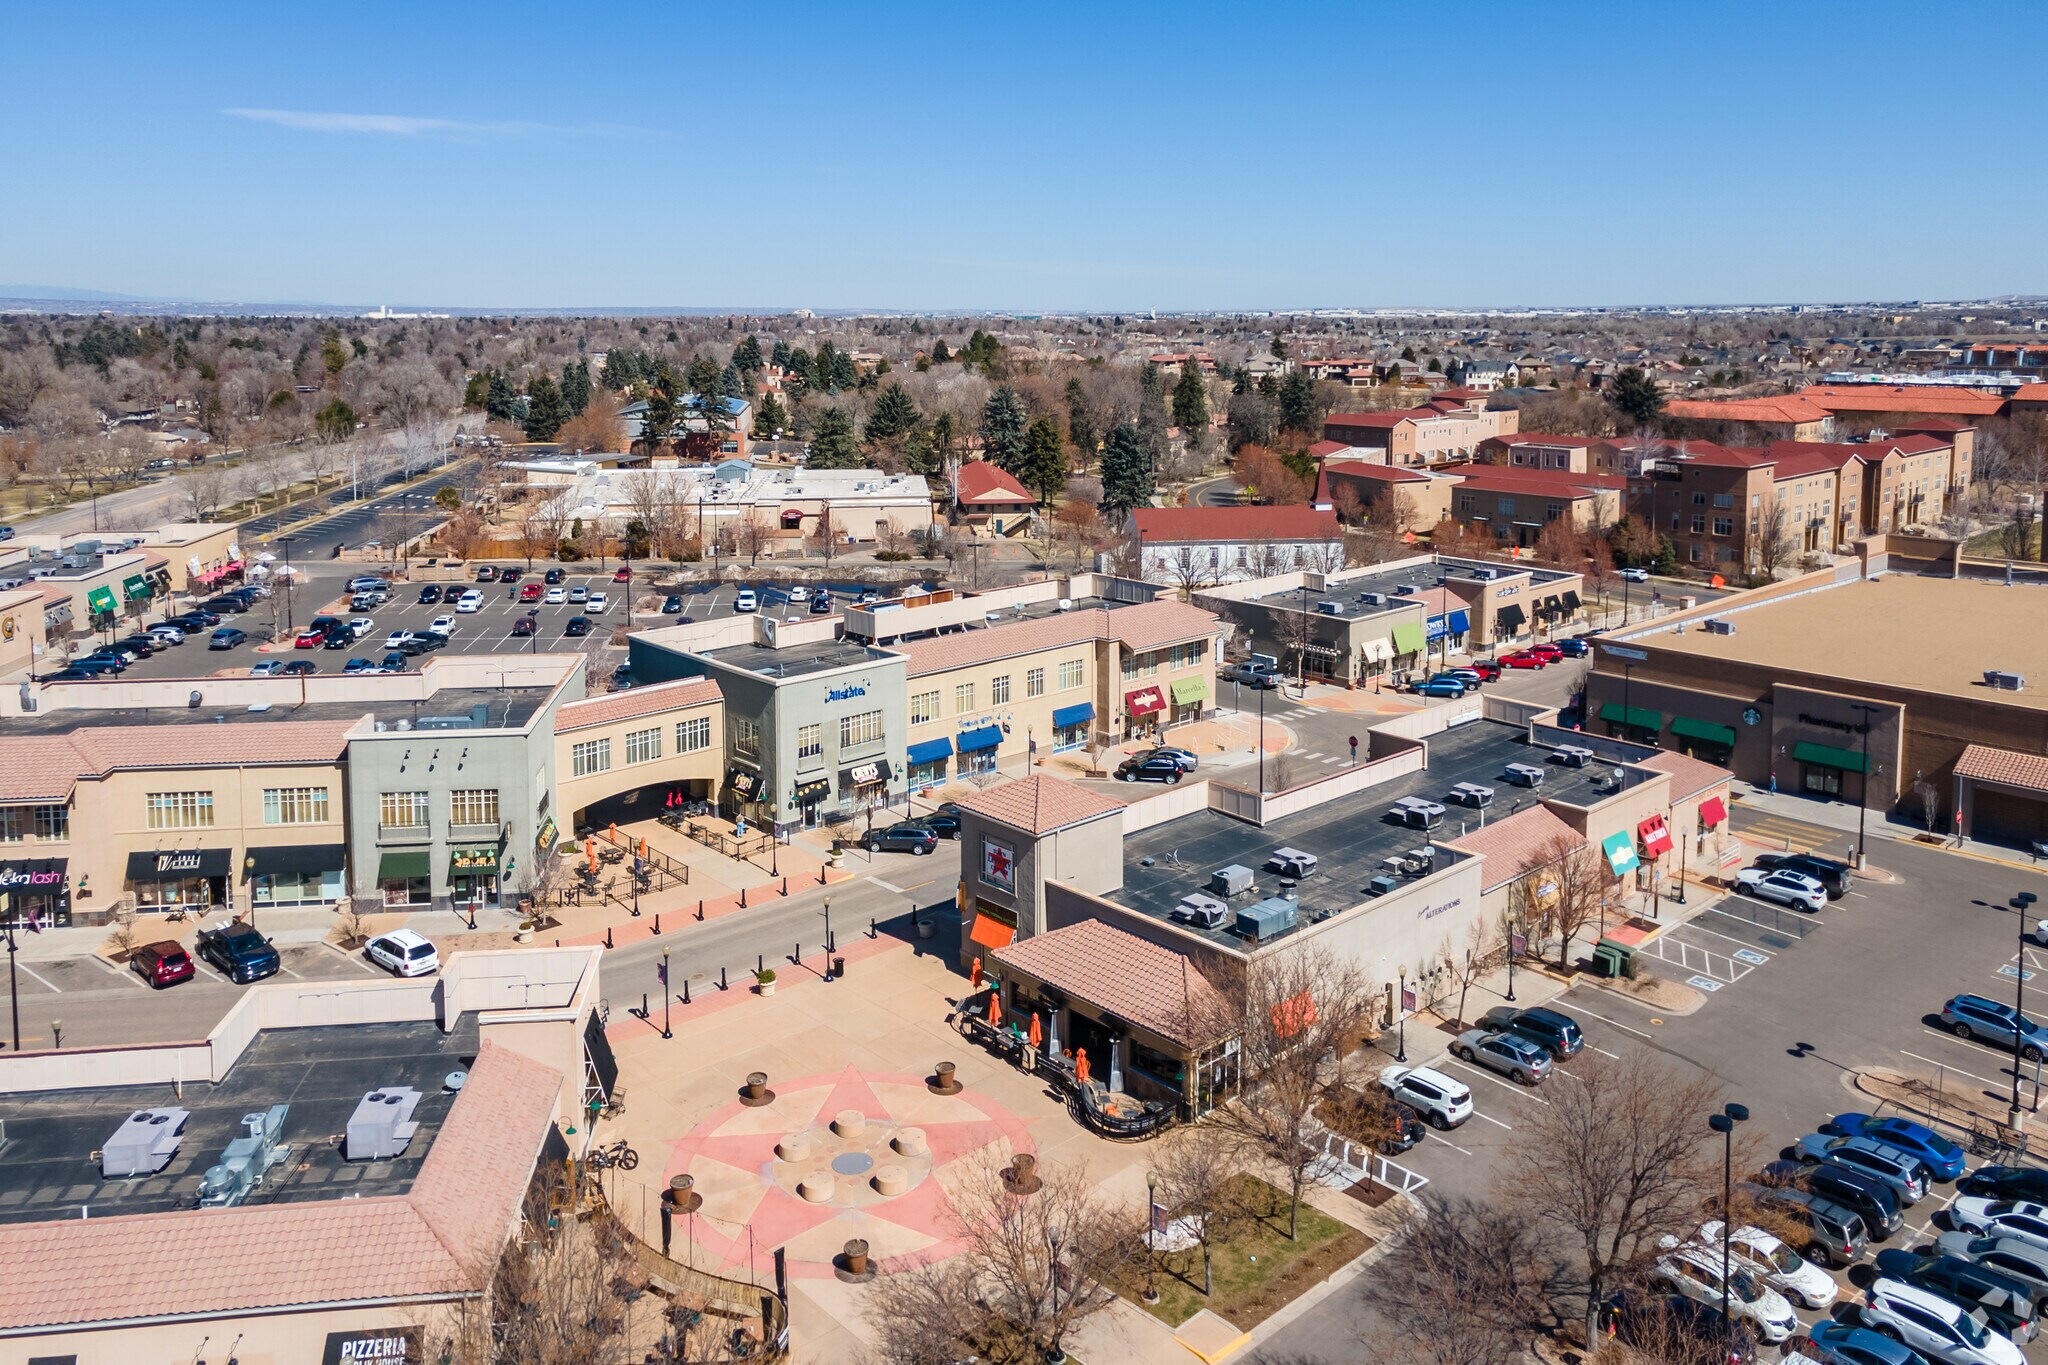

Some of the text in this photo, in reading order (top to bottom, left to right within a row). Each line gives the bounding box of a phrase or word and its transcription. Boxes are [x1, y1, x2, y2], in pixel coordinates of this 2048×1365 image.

[1427, 620, 1444, 630] OWRY
[827, 687, 864, 702] Allstate
[1176, 683, 1206, 695] Marcella's
[1798, 713, 1852, 733] Pharmacy
[31, 871, 60, 884] lash
[1425, 898, 1461, 920] ALTERATIONS
[341, 1337, 406, 1359] PIZZERIA
